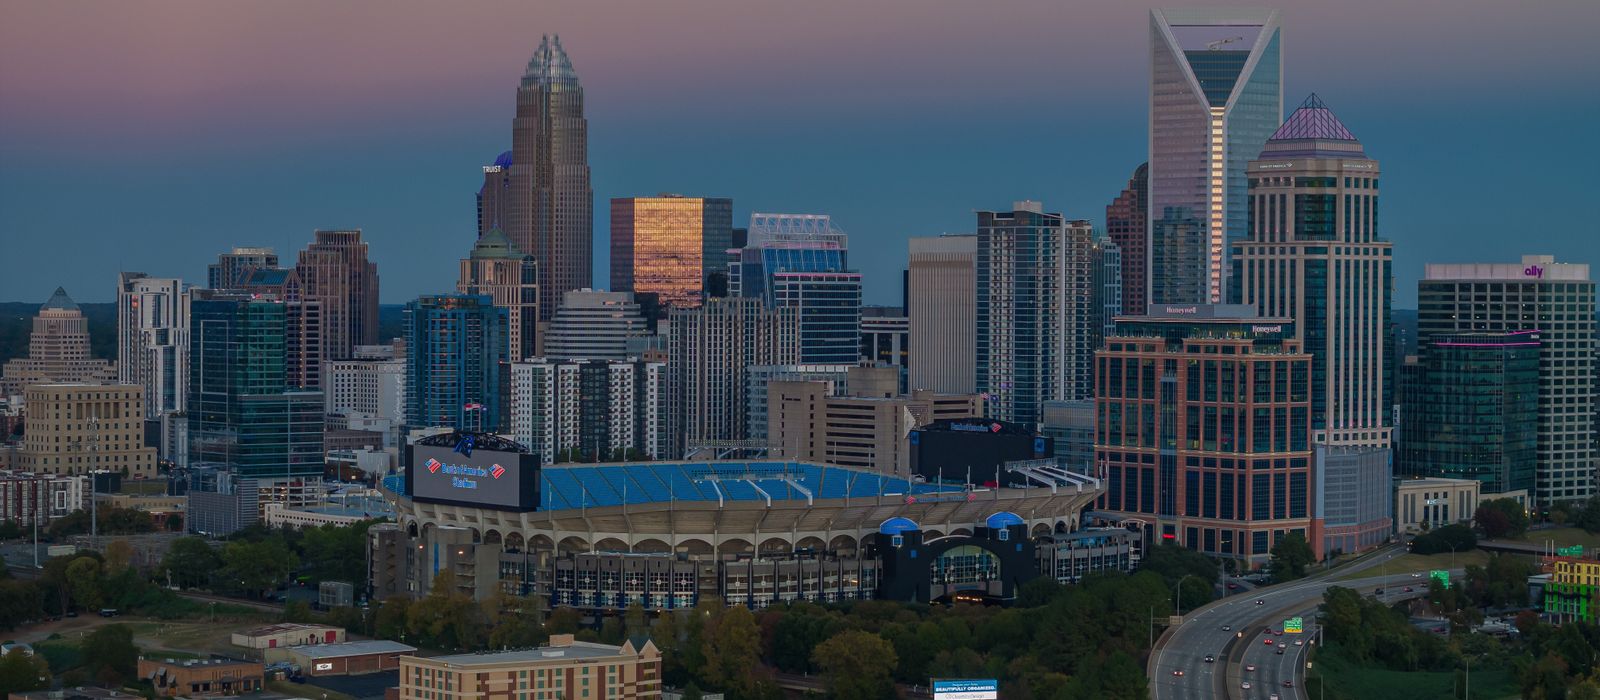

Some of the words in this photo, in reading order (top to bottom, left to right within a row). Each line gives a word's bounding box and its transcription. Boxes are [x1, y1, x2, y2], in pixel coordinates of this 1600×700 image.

[482, 165, 501, 173] TRUIST
[1524, 265, 1543, 278] ally
[1166, 306, 1197, 315] Honeywell
[1252, 325, 1282, 333] Honeywell
